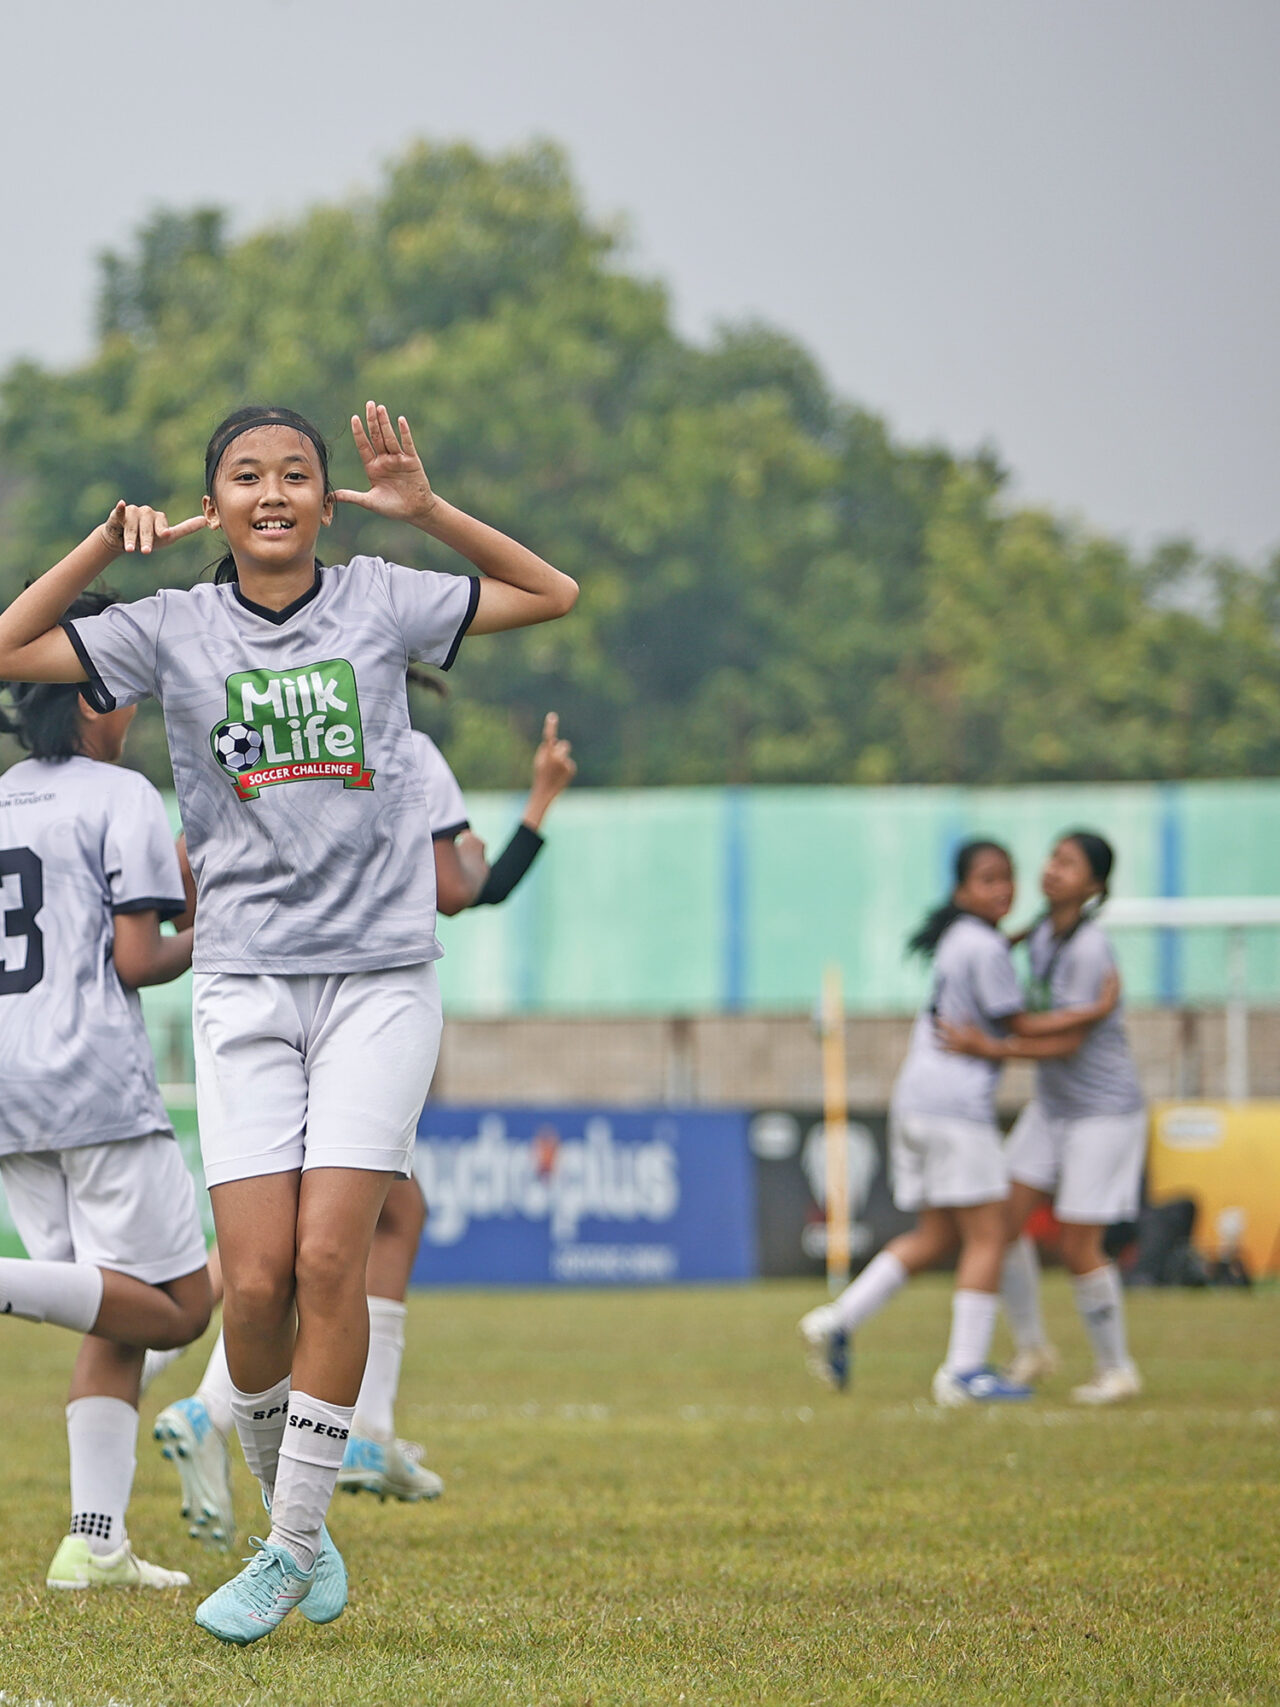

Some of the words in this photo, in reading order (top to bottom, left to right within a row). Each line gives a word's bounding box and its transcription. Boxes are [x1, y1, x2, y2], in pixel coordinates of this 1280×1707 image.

[241, 672, 348, 722] Milk
[262, 715, 356, 763] Life
[248, 767, 290, 786] SOCCER
[292, 764, 354, 776] CHALLENGE
[416, 1113, 680, 1246] ydroplus
[253, 1400, 289, 1420] SPE
[289, 1414, 349, 1440] SPECS
